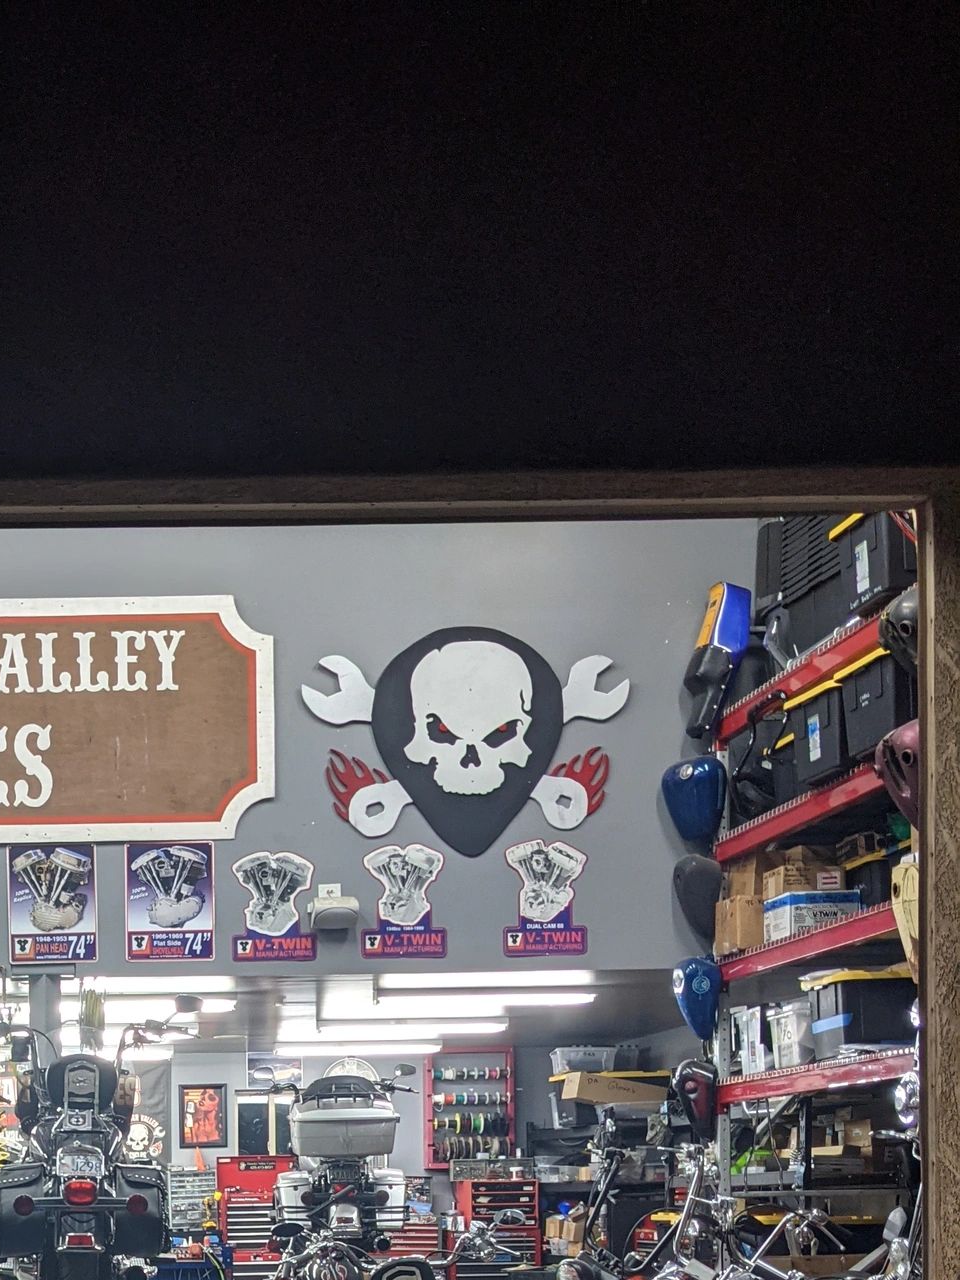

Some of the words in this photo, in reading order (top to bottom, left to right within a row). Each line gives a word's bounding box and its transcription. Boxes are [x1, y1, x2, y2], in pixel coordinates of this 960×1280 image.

[385, 933, 443, 945] V-TWIN
[526, 931, 582, 943] V-TWIN
[36, 943, 49, 953] PAN
[50, 943, 68, 953] HEAD
[255, 937, 312, 949] V-TWIN
[255, 949, 313, 957] MANUFACTURING
[384, 945, 443, 953] MANUFACTURING
